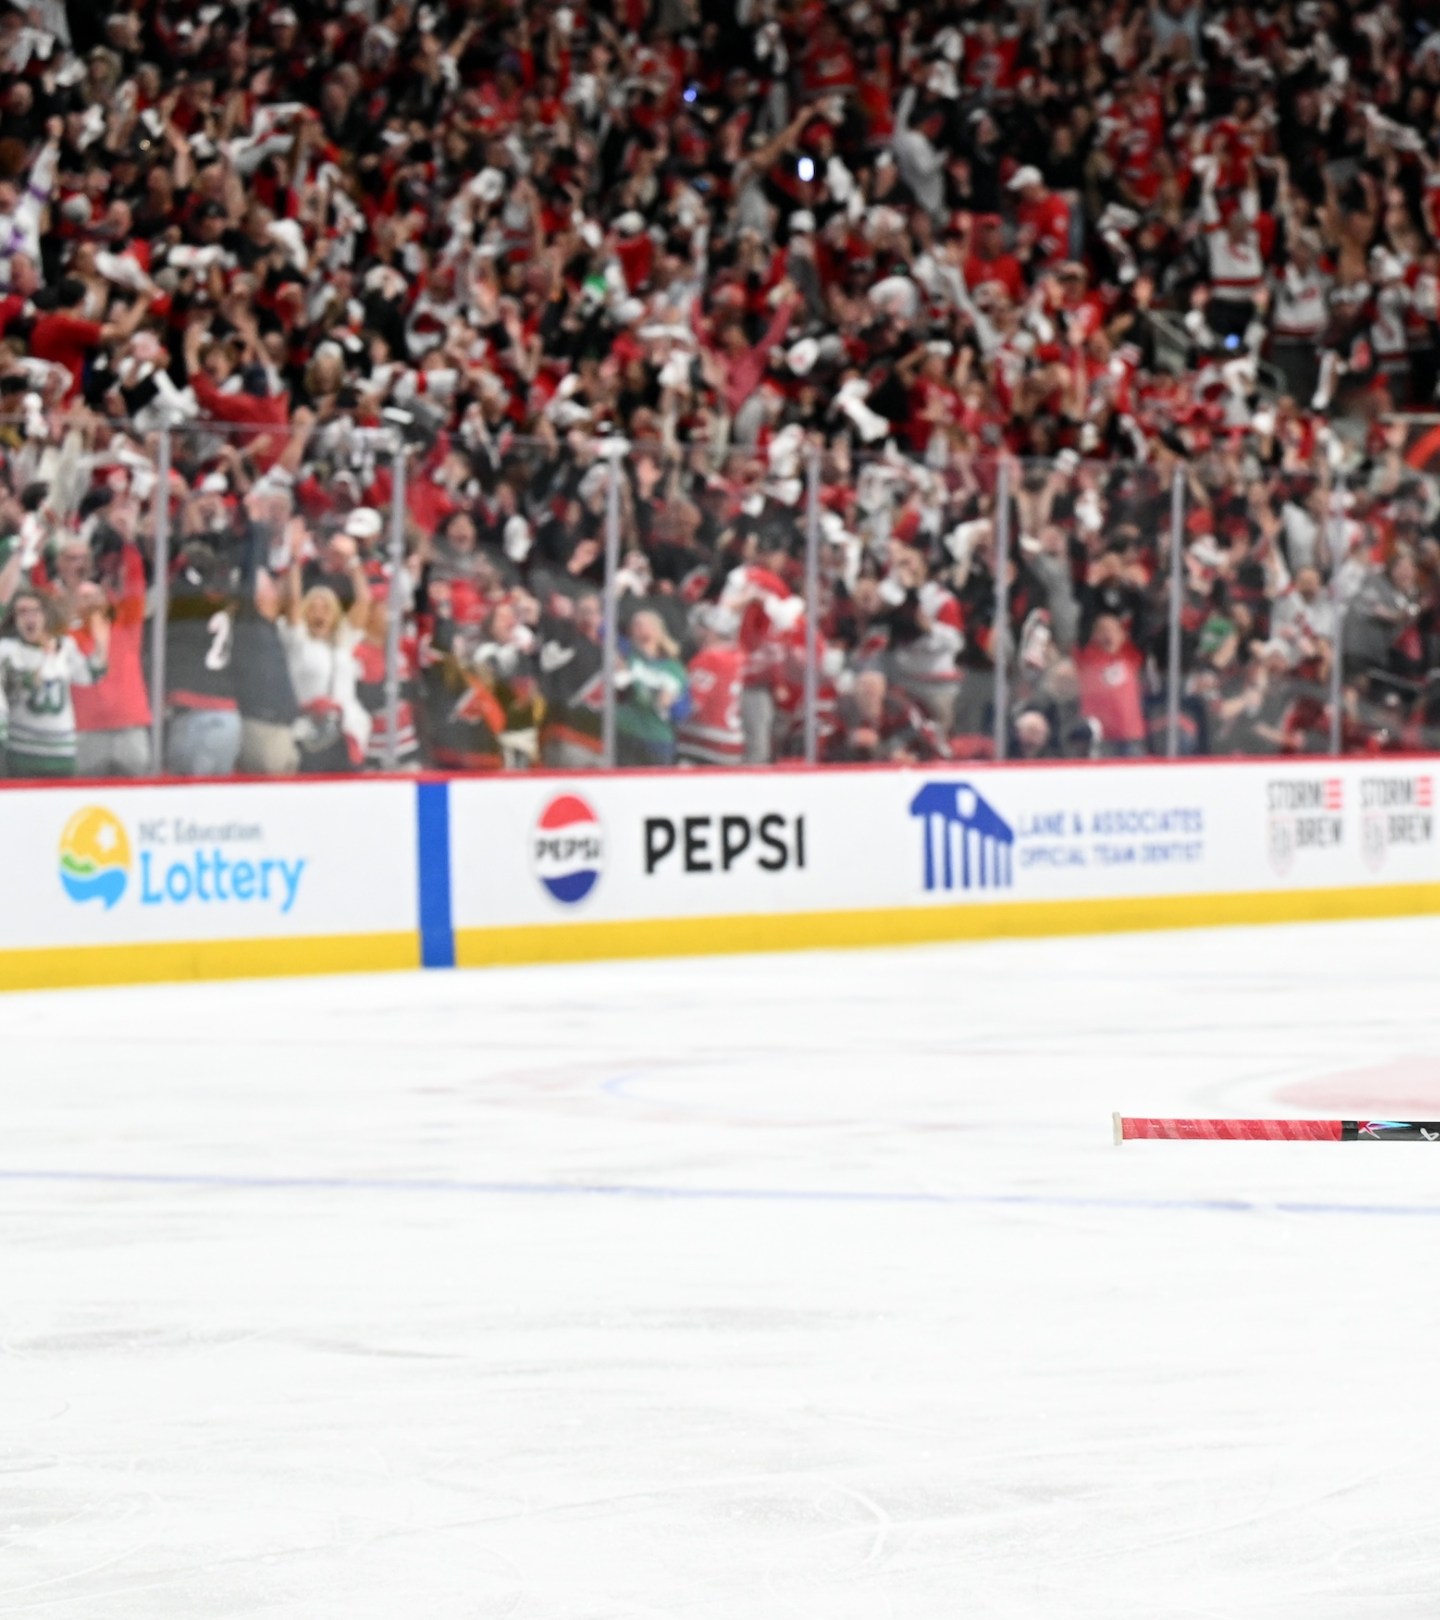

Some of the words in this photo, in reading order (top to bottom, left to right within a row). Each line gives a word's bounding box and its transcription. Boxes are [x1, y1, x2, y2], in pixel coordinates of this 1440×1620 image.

[138, 819, 167, 843] NC
[174, 818, 263, 842] Education
[1091, 806, 1204, 833] ASSOCIATES
[534, 836, 602, 862] PEPSI
[643, 813, 806, 875] PEPSI
[1092, 842, 1136, 864] TEAM
[1140, 838, 1204, 863] DENTIST
[140, 849, 306, 913] Lottery
